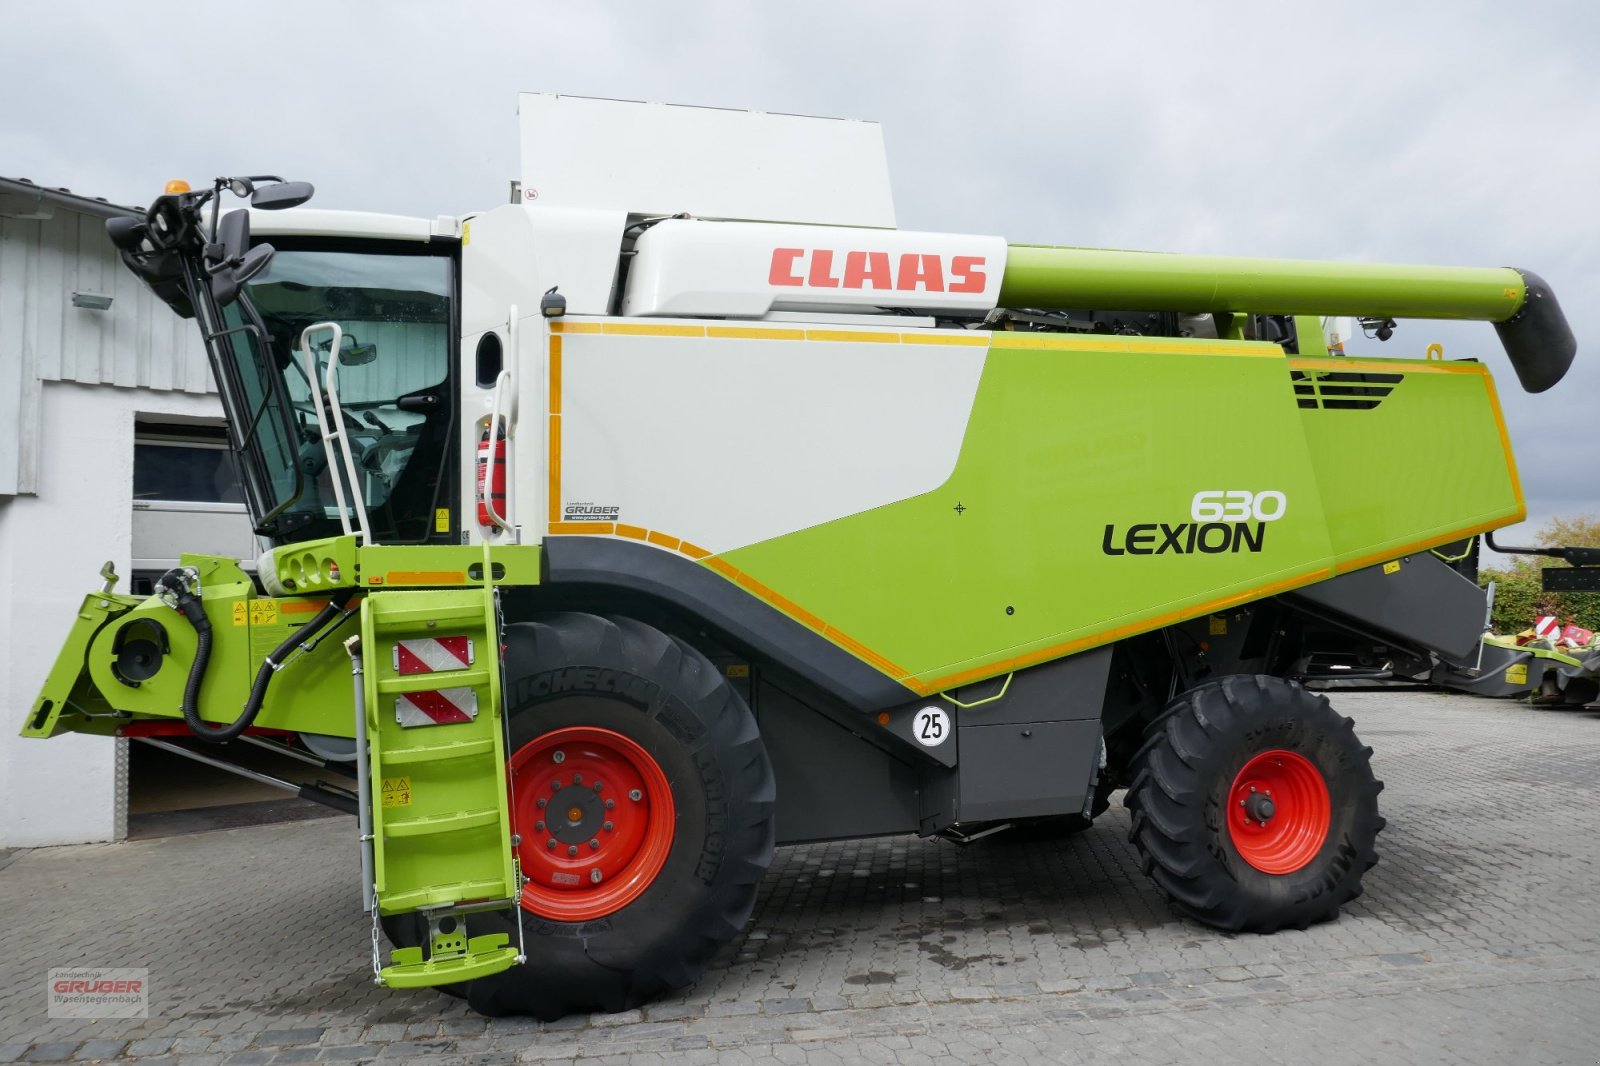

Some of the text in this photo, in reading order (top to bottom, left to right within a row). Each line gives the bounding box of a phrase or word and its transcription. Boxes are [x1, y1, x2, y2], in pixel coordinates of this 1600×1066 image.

[768, 247, 987, 294] CLAAS
[565, 506, 620, 514] GRUBER
[1191, 490, 1287, 522] 630
[1102, 521, 1266, 556] LEXION
[506, 666, 660, 711] ICHELIN
[921, 713, 943, 740] 25
